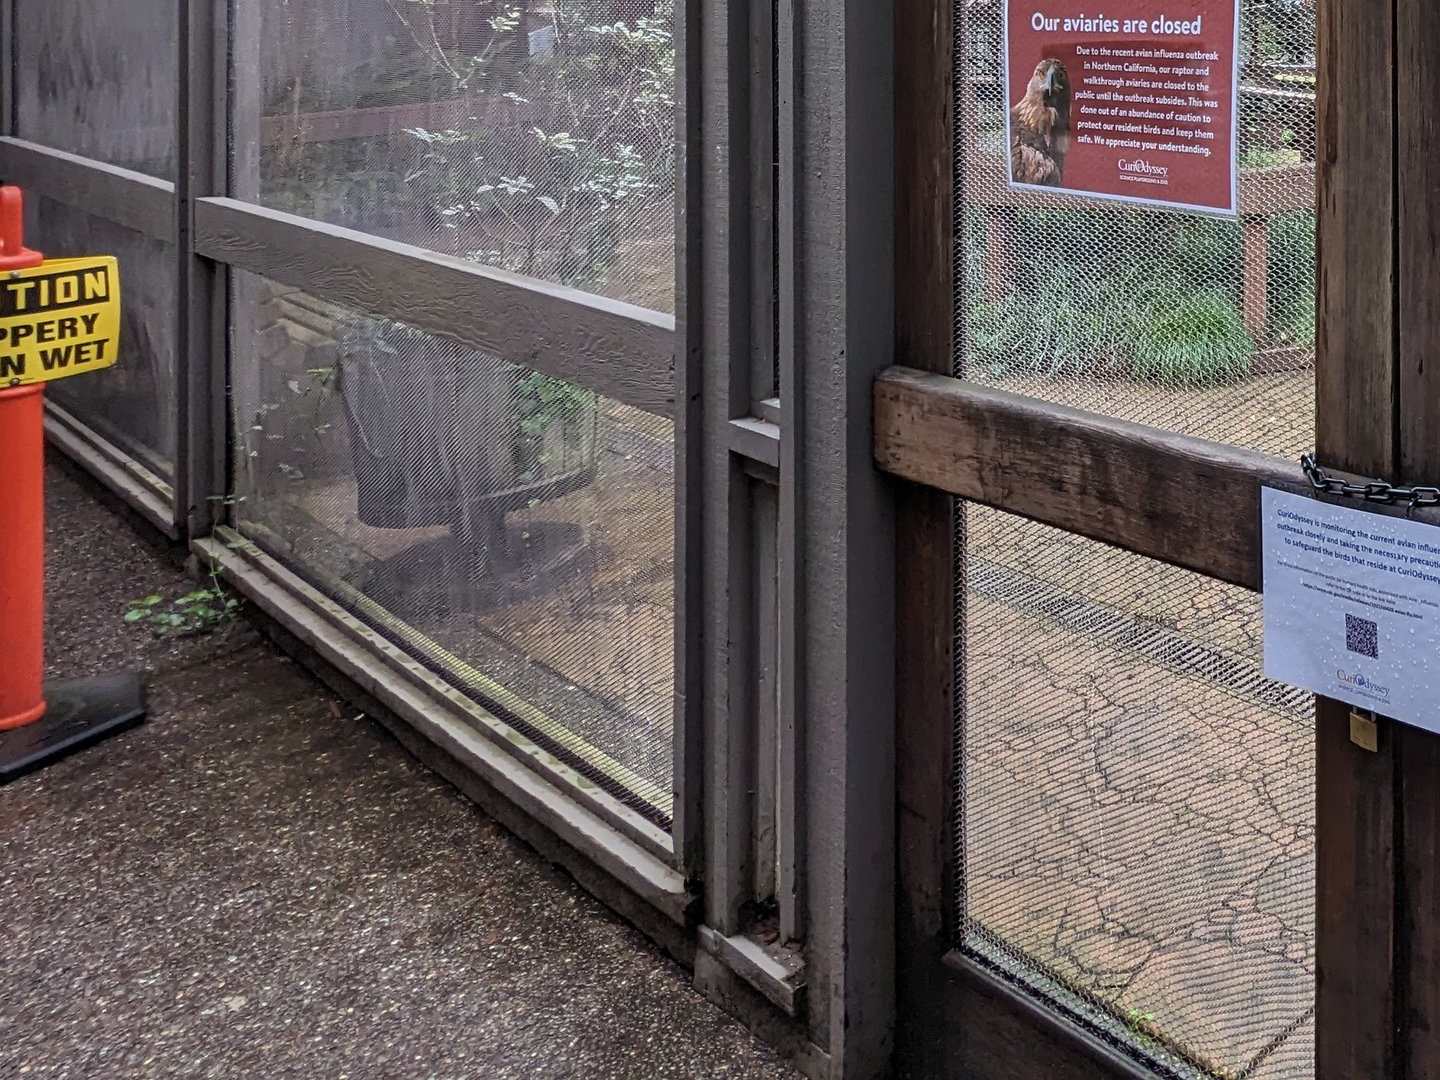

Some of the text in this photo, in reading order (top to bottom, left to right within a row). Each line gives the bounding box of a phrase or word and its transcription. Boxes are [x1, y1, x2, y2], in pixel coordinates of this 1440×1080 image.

[1031, 12, 1201, 34] Our aviaries are closed
[1077, 46, 1090, 55] Due
[1100, 47, 1111, 56] the
[1112, 49, 1134, 57] recent
[1135, 48, 1152, 58] avian
[1154, 49, 1184, 59] influenza
[1185, 51, 1218, 60] outbreak
[1084, 61, 1090, 69] in
[1092, 62, 1122, 71] Northern
[1123, 62, 1157, 74] California,
[1172, 67, 1194, 76] raptor
[1195, 67, 1209, 76] and
[1084, 76, 1124, 88] walkthrough
[1125, 79, 1150, 88] aviaries
[1164, 80, 1185, 90] closed
[1187, 82, 1195, 90] to
[1197, 82, 1209, 91] the
[1075, 91, 1217, 108] public until the outbreak subsides. This was
[1080, 105, 1097, 114] done
[1098, 107, 1109, 115] out
[1110, 107, 1119, 116] of
[1128, 108, 1164, 119] abundance
[1166, 111, 1174, 120] of
[1175, 113, 1201, 122] caution
[1203, 115, 1210, 123] to
[1077, 121, 1213, 139] protect our resident birds and keep them
[1077, 135, 1211, 157] safe. We appreciate your understanding.
[1118, 159, 1168, 177] CuriOdyssey
[39, 339, 110, 371] WET
[1278, 509, 1313, 526] CuriOdyssey
[1321, 522, 1356, 537] monitoring
[1357, 531, 1368, 539] the
[1370, 534, 1395, 545] current
[1397, 540, 1416, 549] avian
[1277, 523, 1304, 535] outbreak
[1327, 537, 1338, 545] and
[1340, 540, 1360, 552] taking
[1361, 545, 1372, 553] the
[1374, 549, 1408, 563] necessary
[1293, 540, 1321, 553] safeguard
[1323, 548, 1333, 557] the
[1335, 552, 1350, 561] birds
[1352, 556, 1365, 565] that
[1367, 560, 1387, 570] reside
[1337, 670, 1390, 697] CuriOdyssey
